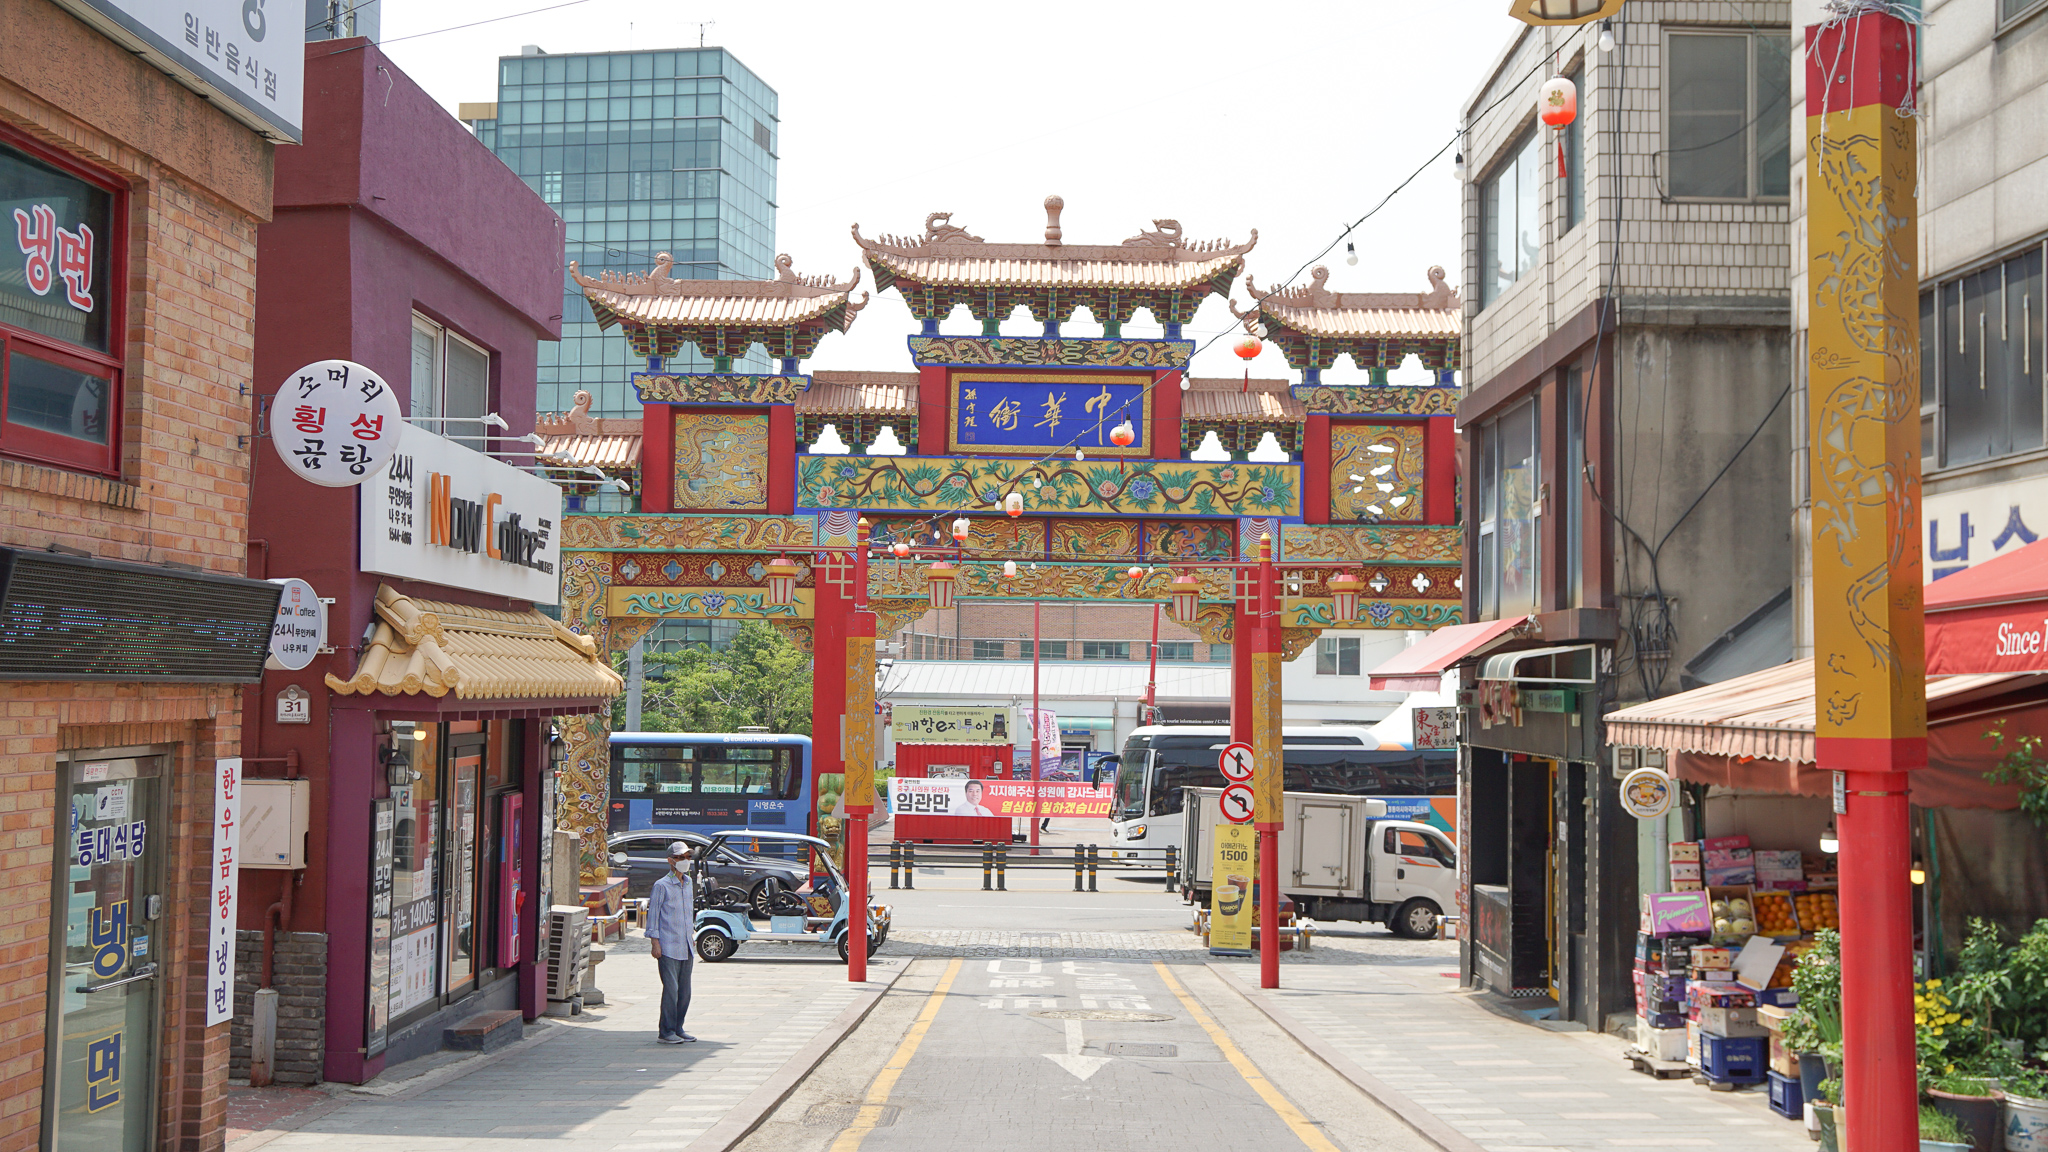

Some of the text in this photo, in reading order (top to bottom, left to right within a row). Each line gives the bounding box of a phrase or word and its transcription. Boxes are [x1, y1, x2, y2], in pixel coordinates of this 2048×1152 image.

[183, 11, 278, 102] 일반음식점
[14, 203, 94, 313] 냉면
[298, 365, 384, 404] 소머리
[291, 404, 385, 441] 횡성
[292, 438, 374, 476] 곰탕
[388, 453, 413, 489] 24시
[388, 485, 413, 511] 무인카페
[388, 508, 413, 528] 나우커피
[486, 492, 540, 569] Coffee
[294, 604, 317, 618] Coffee
[282, 644, 309, 654] 나우커피
[1995, 621, 2041, 656] Since
[284, 701, 302, 713] 31
[110, 788, 124, 796] CCTV
[896, 793, 951, 813] 임관만
[988, 785, 1036, 798] 지지해주신
[1037, 785, 1065, 798] 성원에
[754, 801, 785, 810] 시영운수
[1001, 800, 1112, 815] 열심히 일하겠습니다
[78, 820, 146, 867] 등대식당
[1220, 842, 1248, 850] 아메리카노
[1220, 850, 1248, 862] 1500
[409, 899, 436, 929] 1400원
[87, 900, 129, 1115] 냉면
